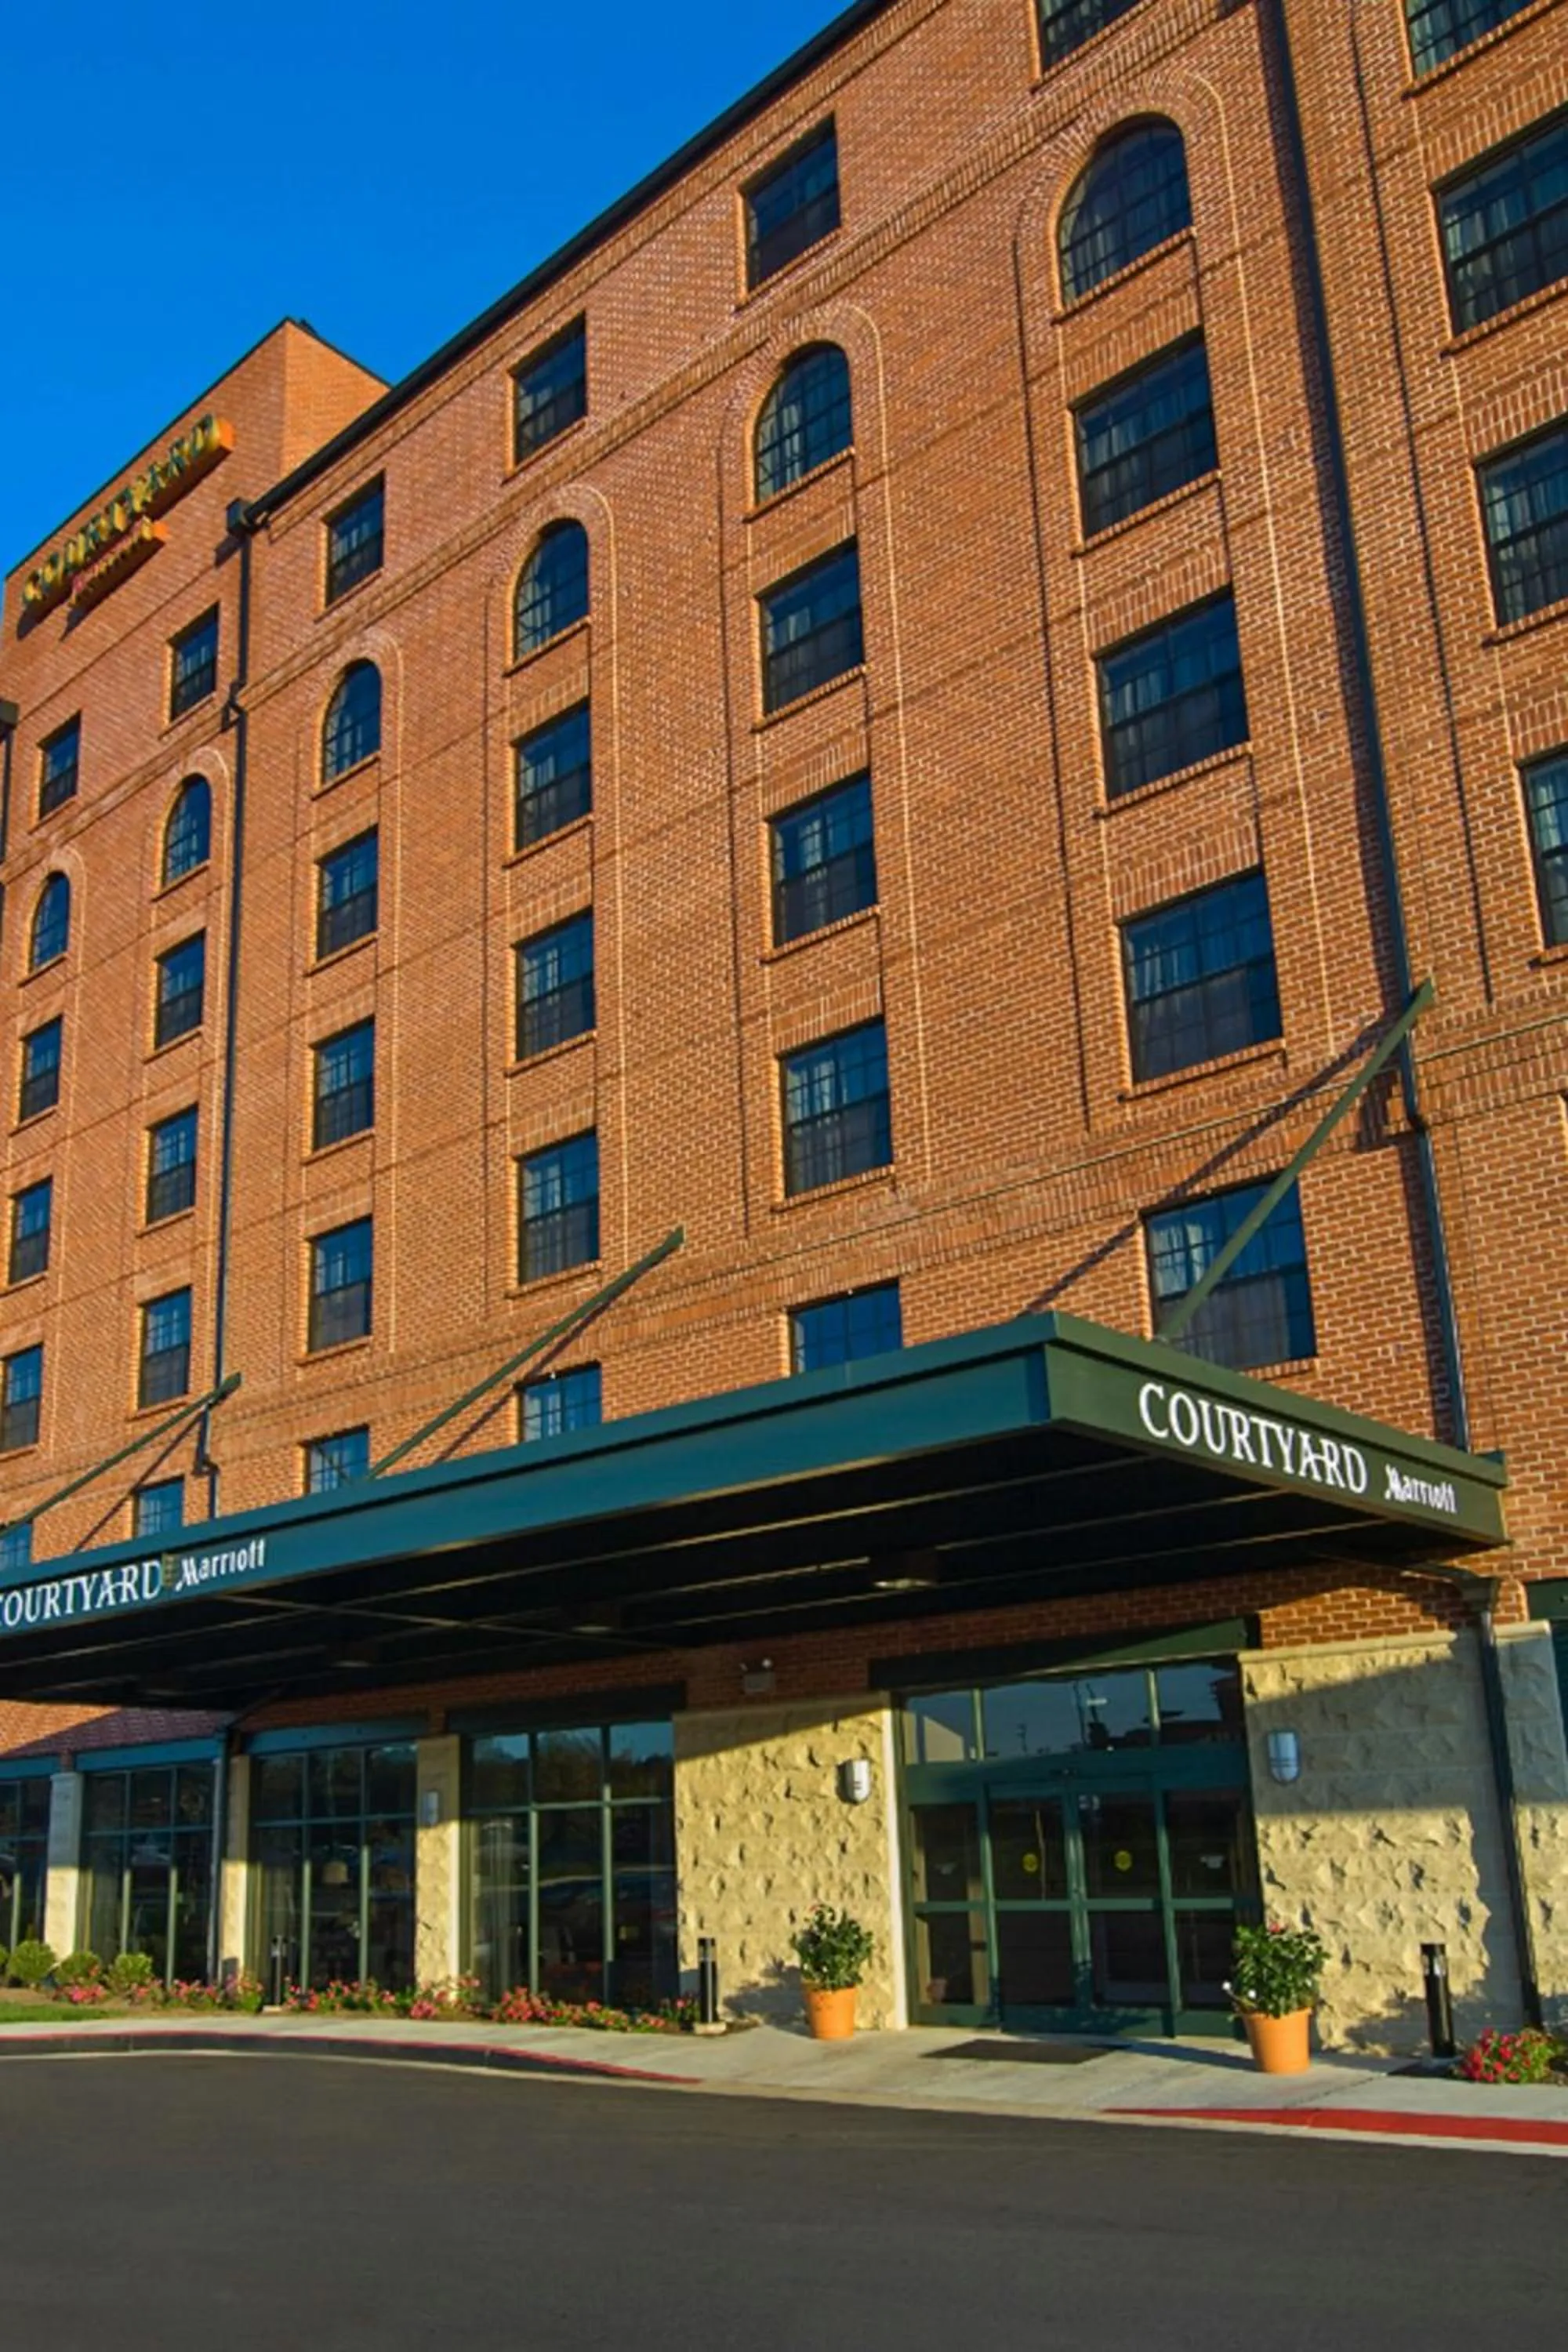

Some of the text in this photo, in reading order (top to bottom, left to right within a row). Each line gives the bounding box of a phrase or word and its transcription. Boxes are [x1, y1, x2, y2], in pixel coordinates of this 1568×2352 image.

[1138, 1382, 1457, 1514] COURTYARD Marriott
[0, 1537, 266, 1627] OURTYARD Marriott
